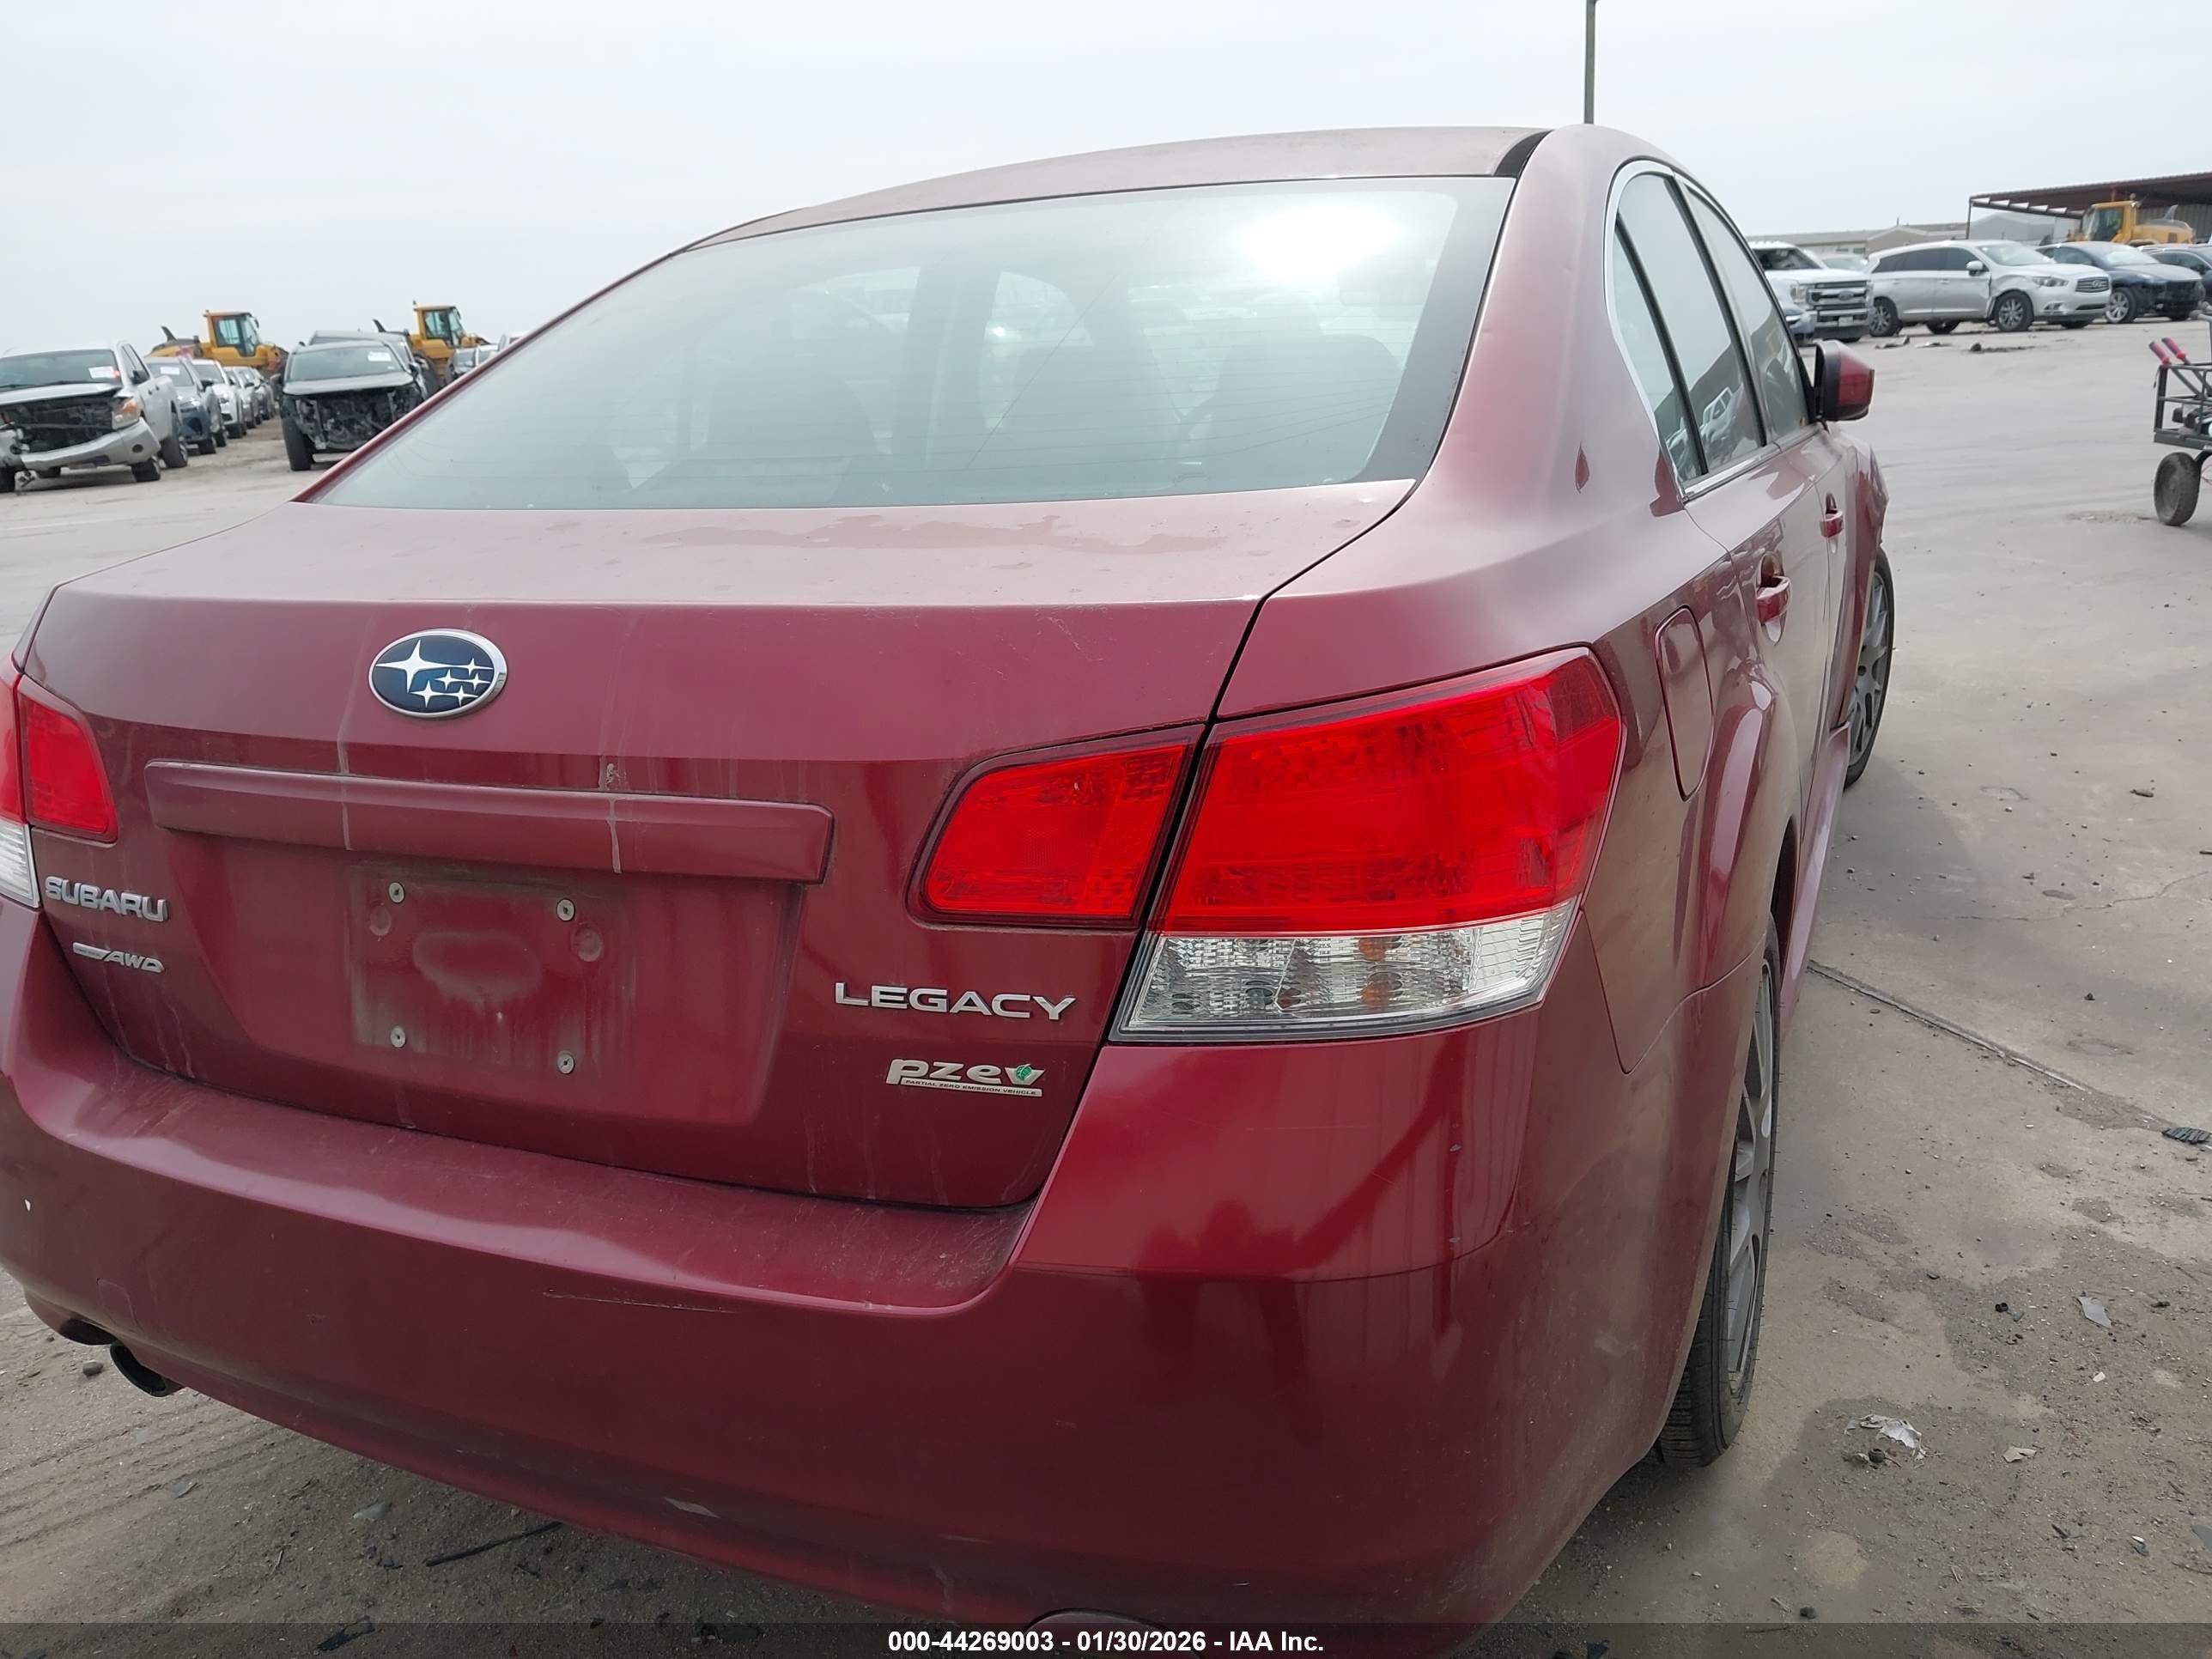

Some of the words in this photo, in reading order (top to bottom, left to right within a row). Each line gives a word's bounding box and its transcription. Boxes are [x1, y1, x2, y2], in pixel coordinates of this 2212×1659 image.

[45, 875, 168, 923] SUBARU
[104, 951, 165, 973] AWD
[835, 982, 1077, 1021] LEGACY
